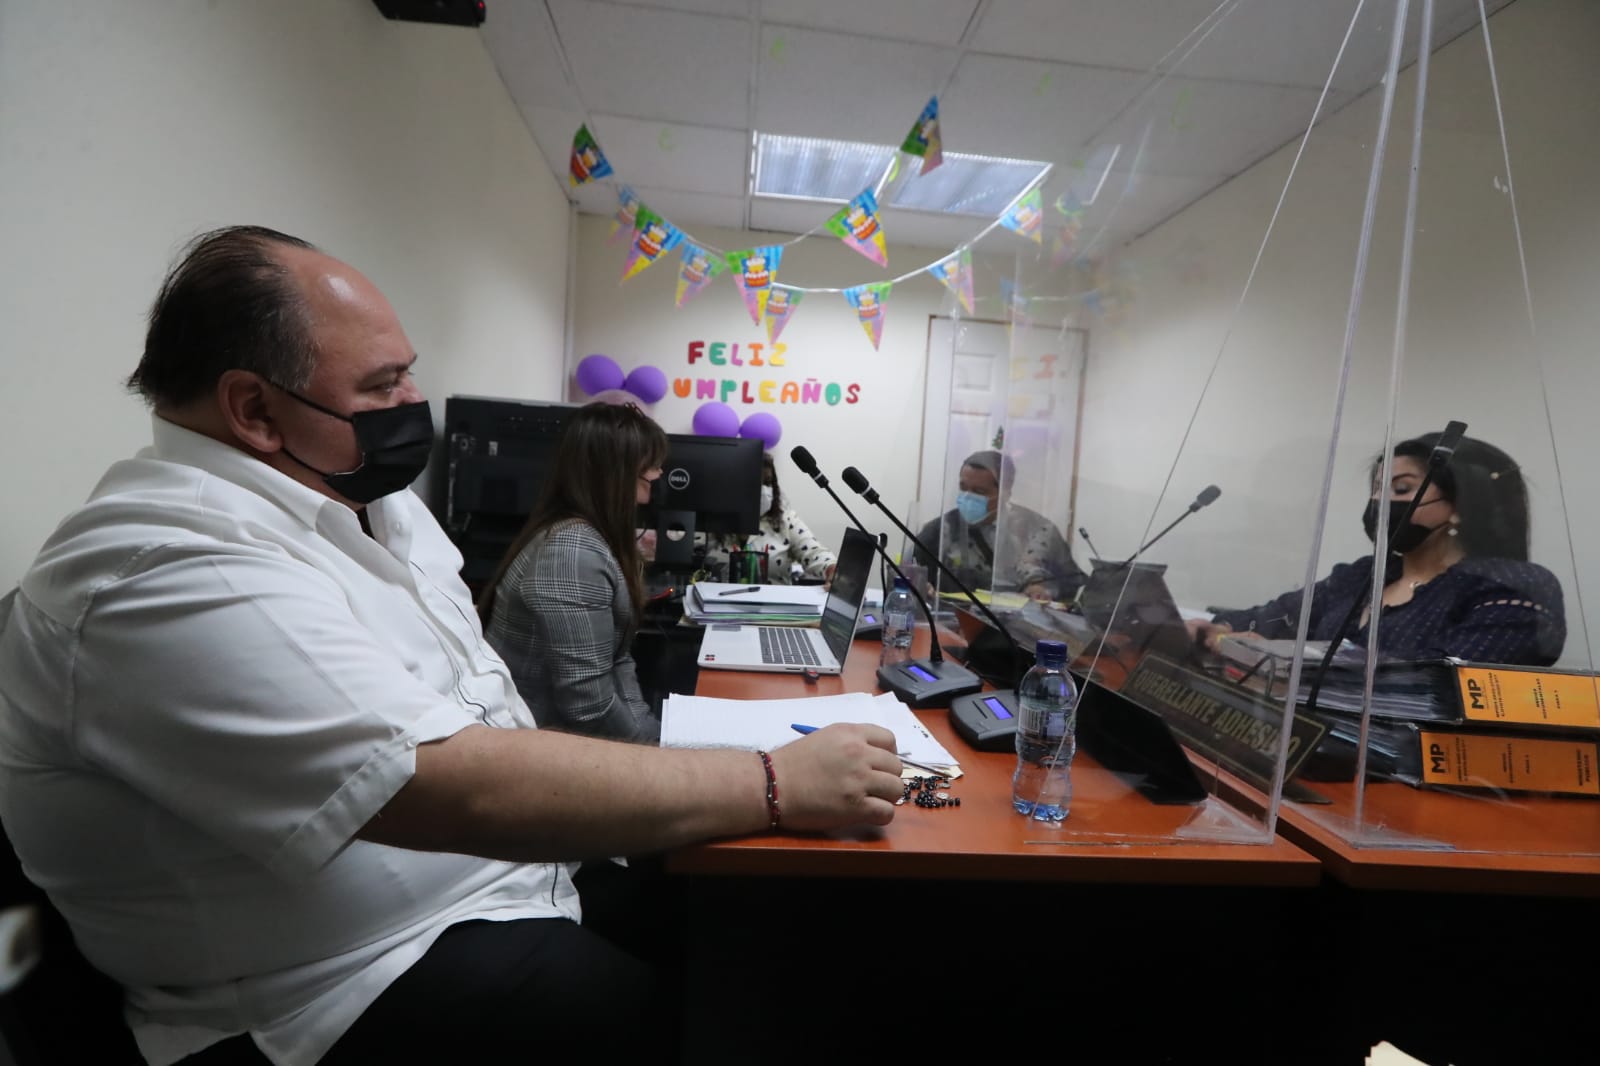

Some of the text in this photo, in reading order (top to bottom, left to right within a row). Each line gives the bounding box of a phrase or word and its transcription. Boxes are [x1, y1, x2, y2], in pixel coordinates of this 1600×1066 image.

[687, 340, 787, 366] FELIZ
[1467, 678, 1485, 710] MP
[1134, 672, 1300, 760] QUERELLANTE ADHESIO
[1430, 743, 1446, 774] MP
